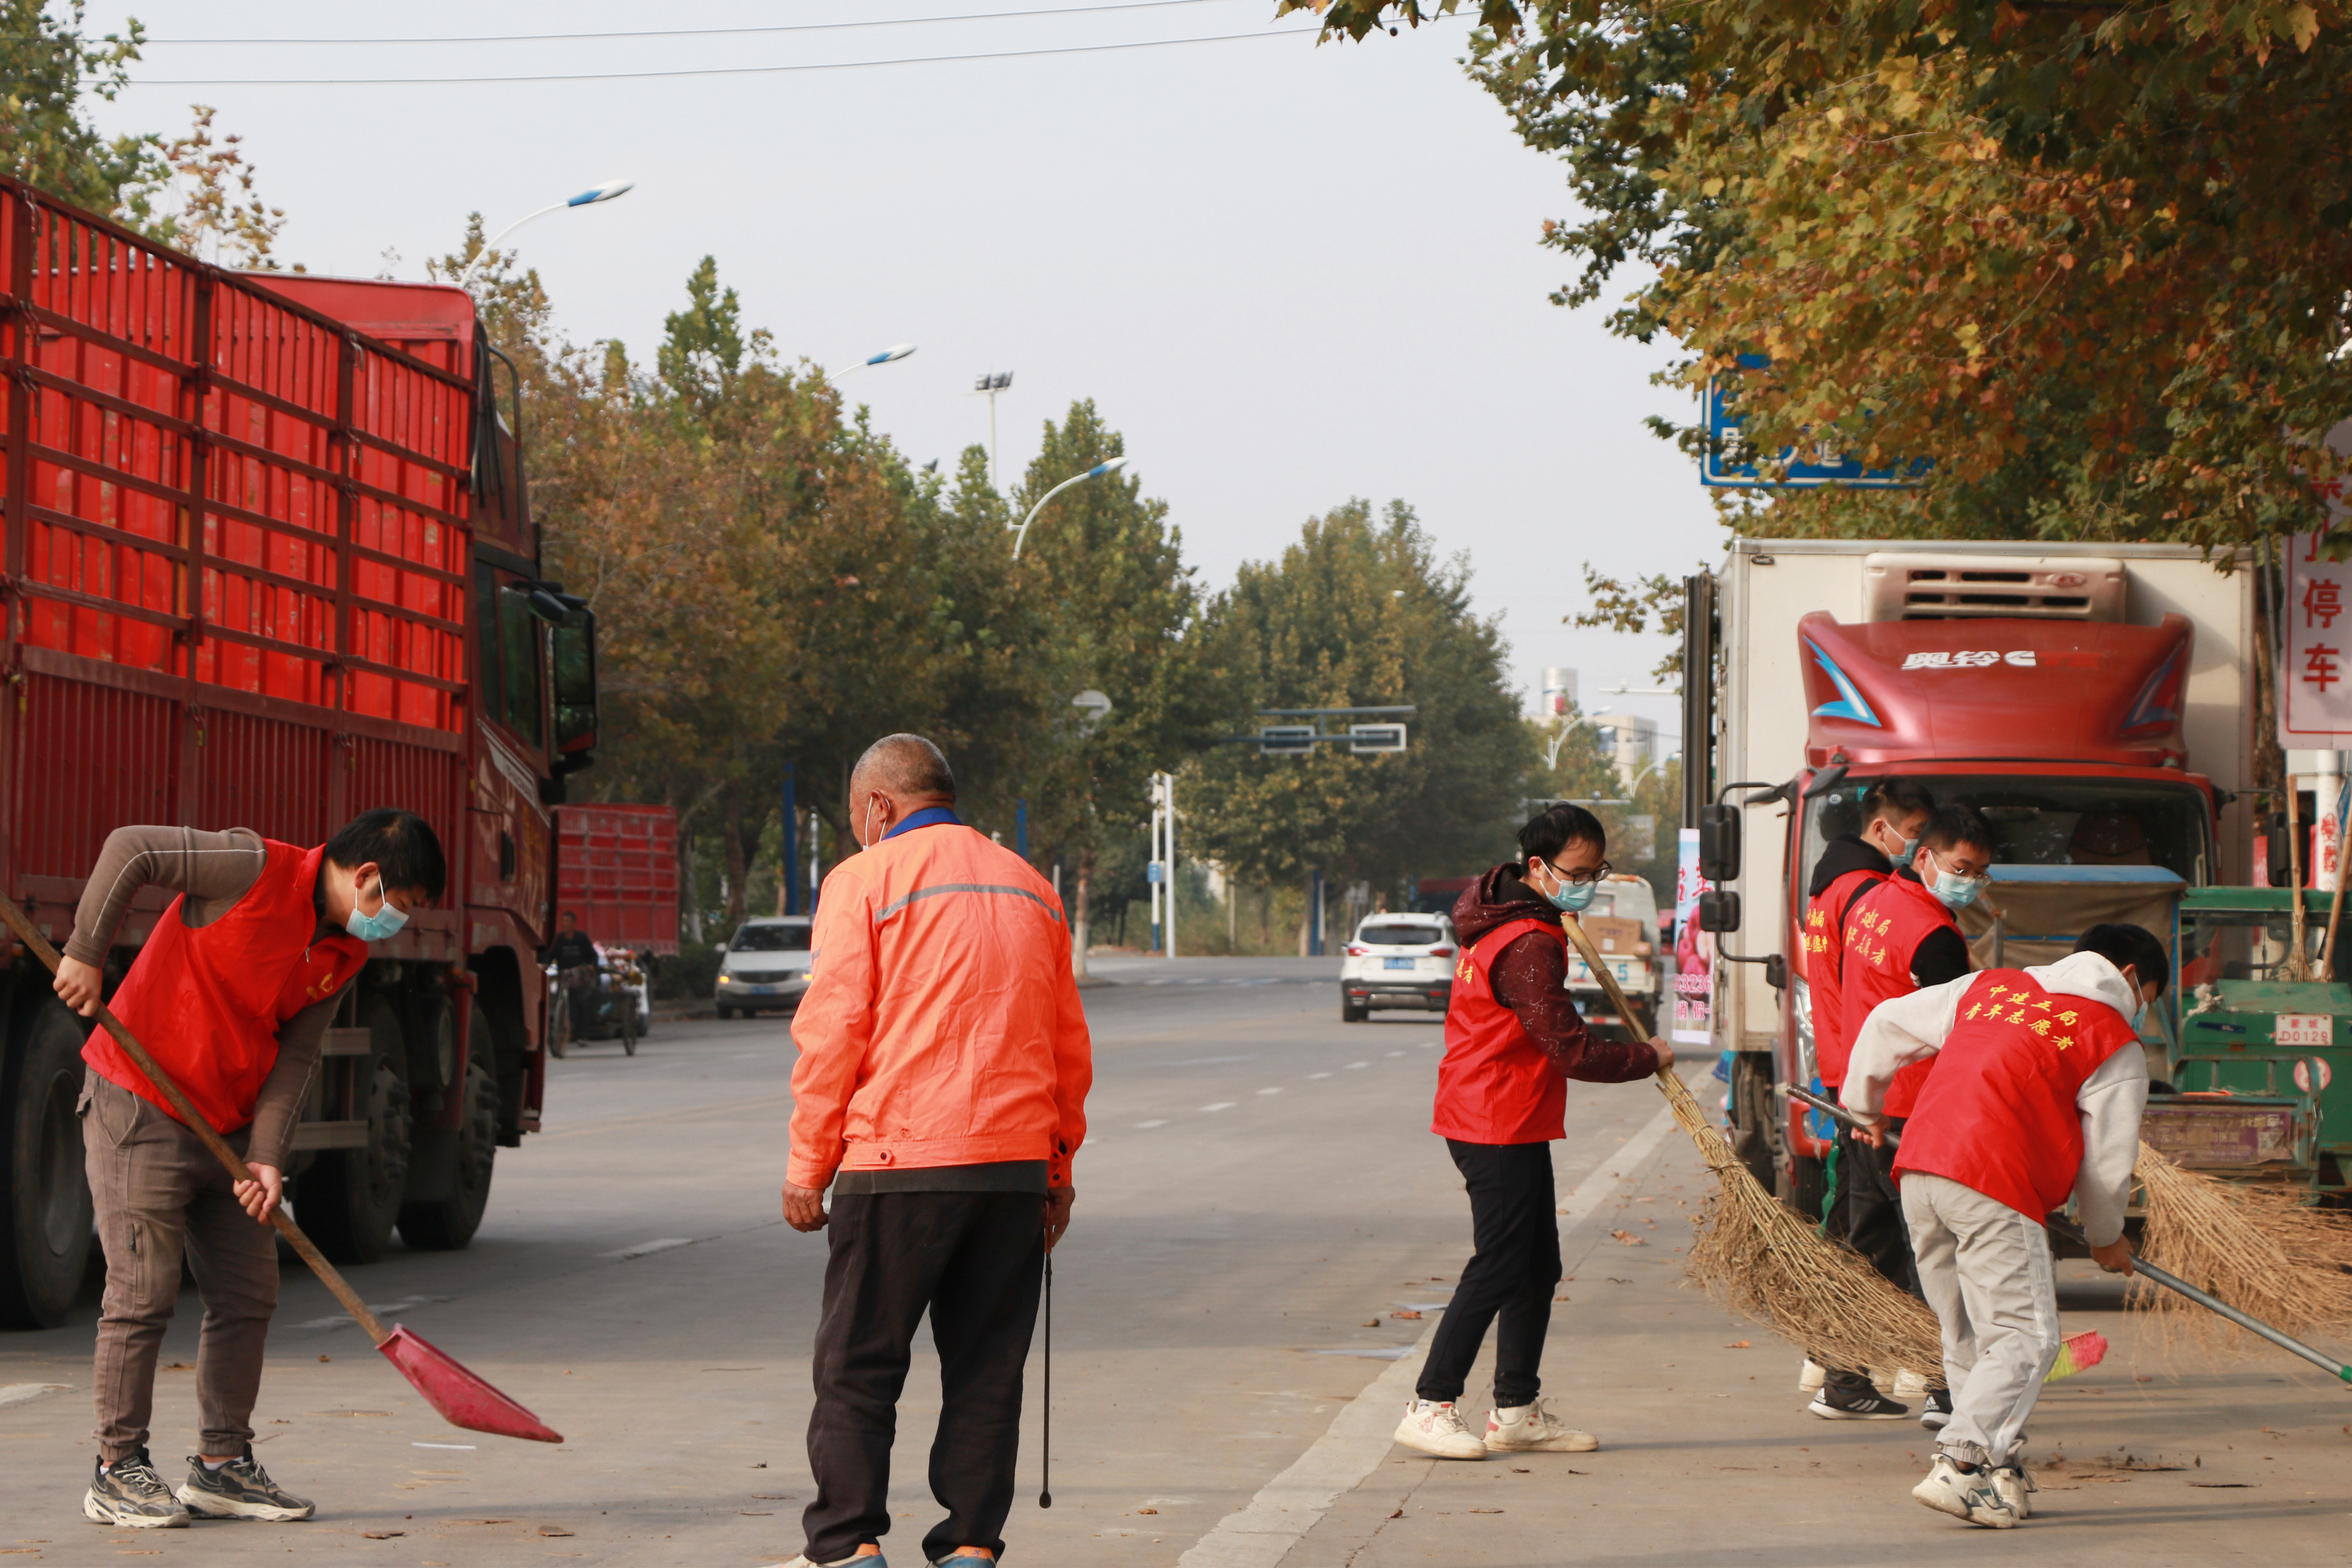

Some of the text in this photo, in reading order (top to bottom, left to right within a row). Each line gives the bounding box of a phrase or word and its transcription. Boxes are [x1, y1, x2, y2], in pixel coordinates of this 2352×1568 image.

[1965, 1002, 2074, 1050] 青年志愿者
[1990, 985, 2079, 1026] 中建五局
[2282, 1030, 2328, 1042] D0129
